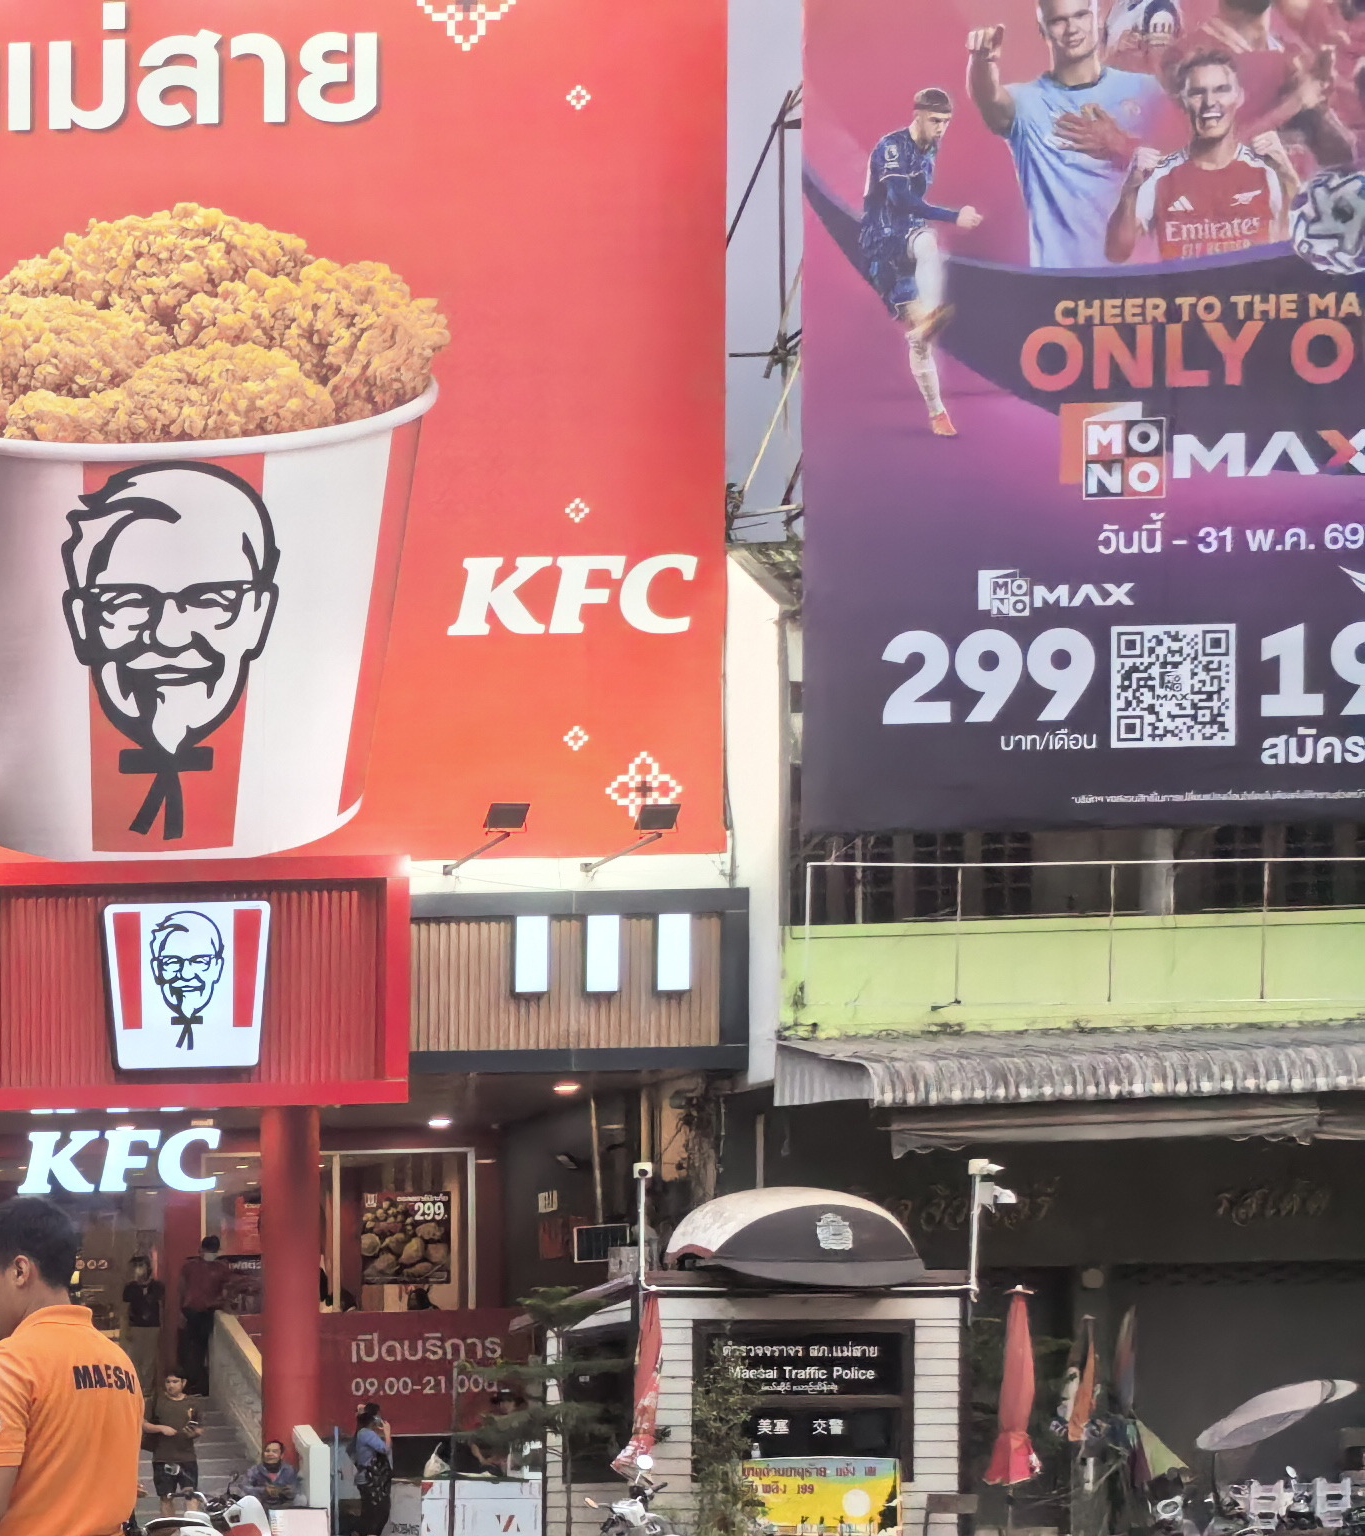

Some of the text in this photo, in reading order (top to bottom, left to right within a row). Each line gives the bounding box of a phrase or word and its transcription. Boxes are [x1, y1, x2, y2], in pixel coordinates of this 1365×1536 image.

[1165, 217, 1261, 242] Emirates
[1054, 298, 1167, 326] CHEER
[1175, 296, 1222, 323] TO
[1230, 294, 1299, 321] THE
[1020, 321, 1265, 392] ONLY
[1097, 512, 1166, 554] วันนี้
[1197, 526, 1233, 553] 31
[1246, 527, 1316, 551] พ.ค.
[1324, 523, 1365, 549] 69
[447, 554, 698, 637] KFC
[1033, 582, 1136, 607] MAX
[881, 627, 1096, 726] 299
[1000, 728, 1097, 751] บาท/เดือน
[1261, 726, 1365, 765] สมัคร
[17, 1127, 222, 1195] KFC
[351, 1332, 502, 1363] เปิดบริการ
[351, 1374, 498, 1397] 09.00-2100น.
[729, 1366, 875, 1379] Maesai Traffic Police
